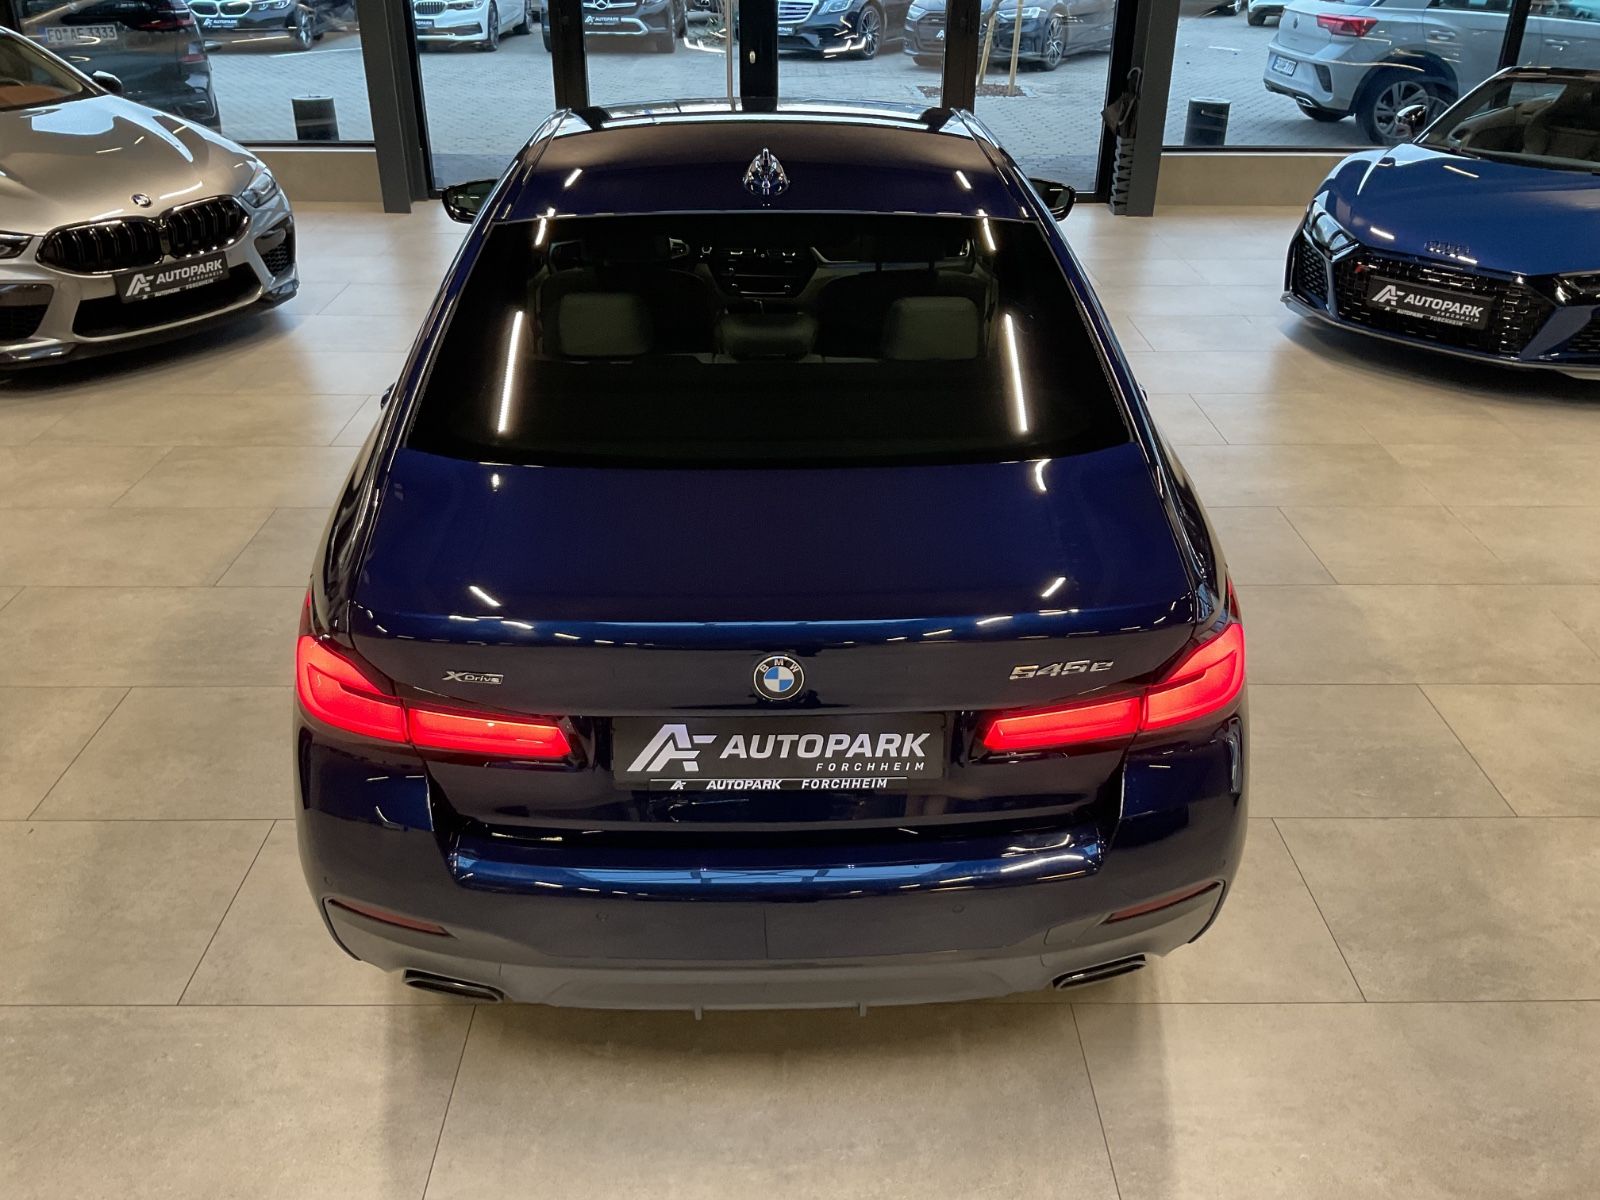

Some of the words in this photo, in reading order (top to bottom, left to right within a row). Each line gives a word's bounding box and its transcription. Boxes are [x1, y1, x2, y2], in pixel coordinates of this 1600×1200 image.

[156, 259, 223, 284] AUTOPARK
[1403, 293, 1484, 318] AUTOPARK
[759, 658, 800, 673] BMW
[1009, 659, 1115, 680] 545e
[719, 732, 931, 760] AUTOPARK
[815, 762, 925, 772] FORCHHEIM
[705, 778, 783, 791] AUTOPARK
[801, 778, 888, 790] FORCHHEIM
